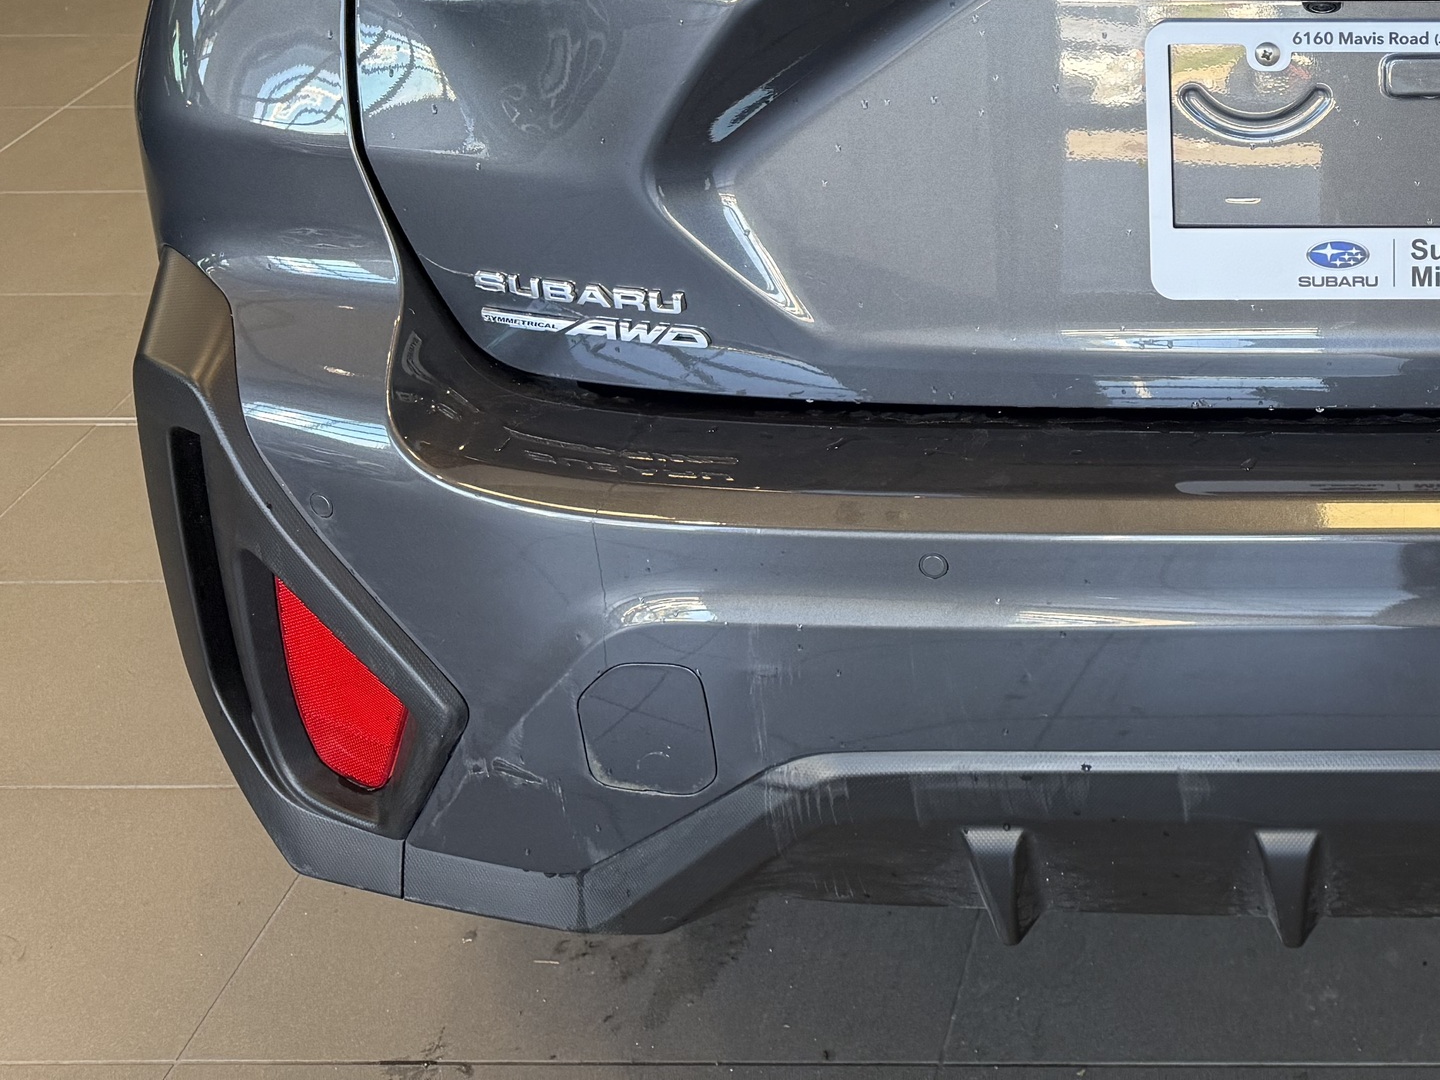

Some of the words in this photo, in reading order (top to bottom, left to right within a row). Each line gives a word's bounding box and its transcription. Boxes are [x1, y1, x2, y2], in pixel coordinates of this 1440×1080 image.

[1292, 31, 1334, 45] 6160
[1338, 31, 1385, 45] Mavis
[1389, 31, 1429, 45] Road
[473, 269, 688, 315] SUBARU
[1298, 275, 1379, 288] SUBARU
[482, 313, 558, 330] SYMMETRICAL
[564, 315, 713, 349] AWD
